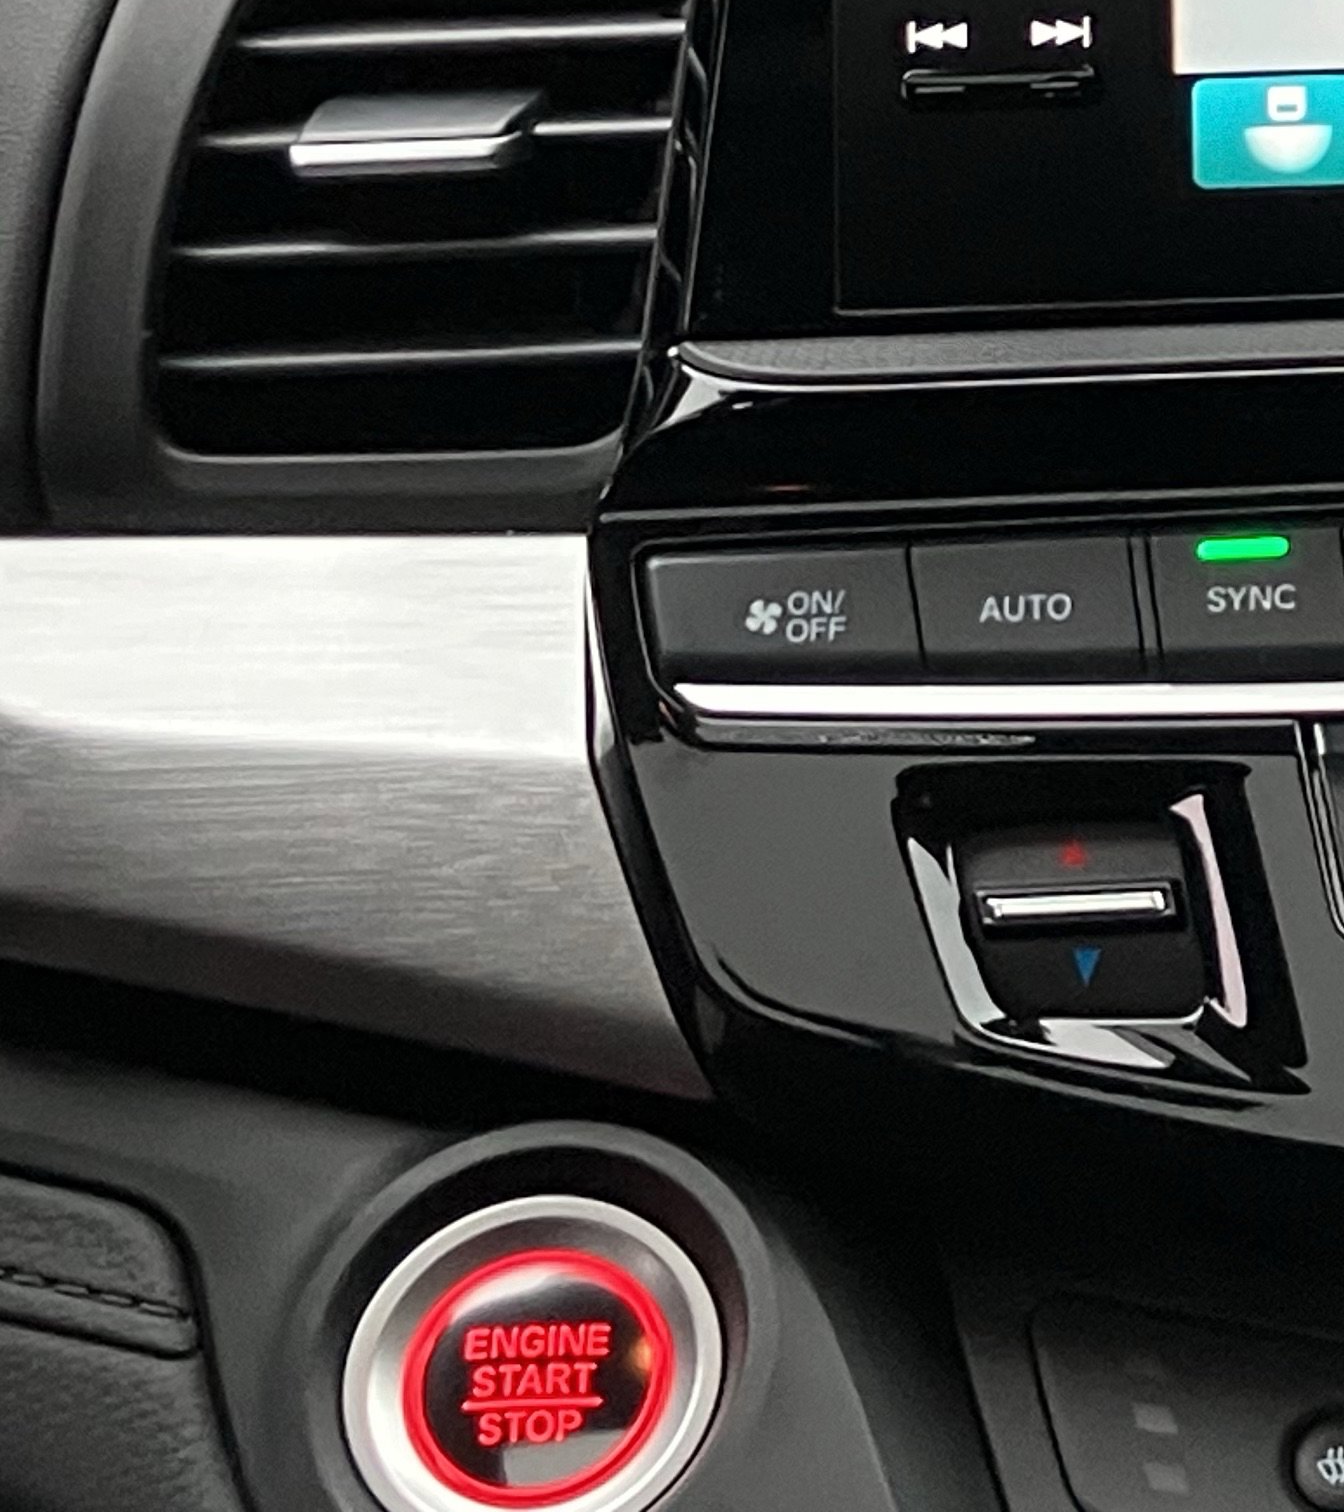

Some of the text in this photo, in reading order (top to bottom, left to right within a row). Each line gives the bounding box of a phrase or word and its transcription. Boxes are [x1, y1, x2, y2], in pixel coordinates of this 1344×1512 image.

[979, 593, 1072, 623] AUTO
[1207, 583, 1296, 613] SYNC
[785, 611, 846, 644] OFF
[463, 1322, 612, 1361] ENGINE
[472, 1363, 597, 1398] START
[477, 1409, 582, 1446] STOP
